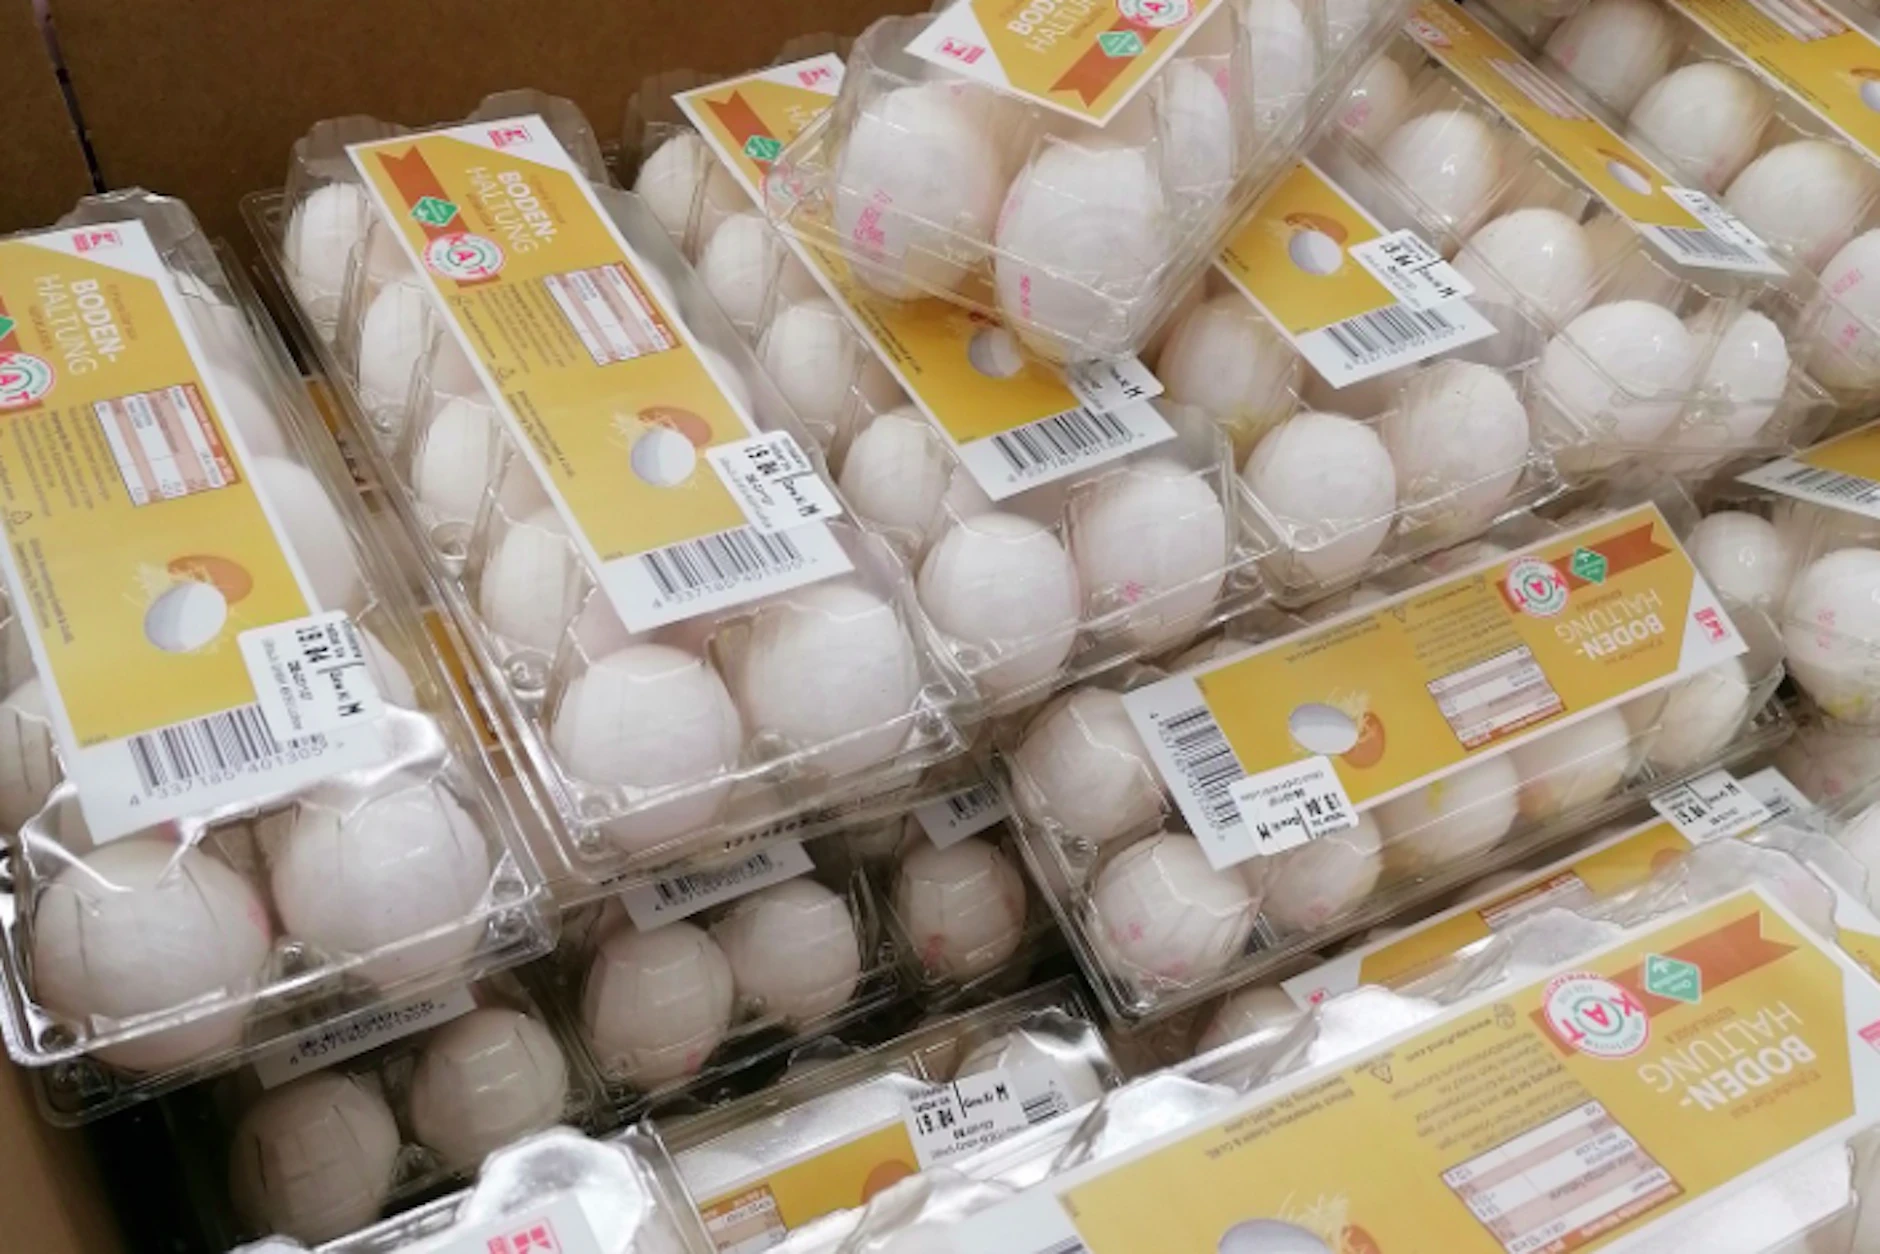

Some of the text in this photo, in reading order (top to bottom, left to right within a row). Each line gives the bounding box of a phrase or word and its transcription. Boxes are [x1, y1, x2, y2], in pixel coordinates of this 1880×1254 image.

[1007, 0, 1060, 36] BOD
[465, 165, 539, 255] HALTUNG
[496, 171, 560, 243] BODEN-
[447, 232, 488, 277] KAT
[34, 273, 97, 375] HALTUNG
[70, 278, 126, 362] BODEN-
[1512, 571, 1566, 604] KAT
[1552, 587, 1662, 645] HALTUNG
[1574, 611, 1665, 660] BODEN-
[1558, 990, 1641, 1043] KAT
[1635, 997, 1803, 1097] HALTUNG
[1677, 1033, 1817, 1111] BODEN-
[993, 1081, 1009, 1102] M
